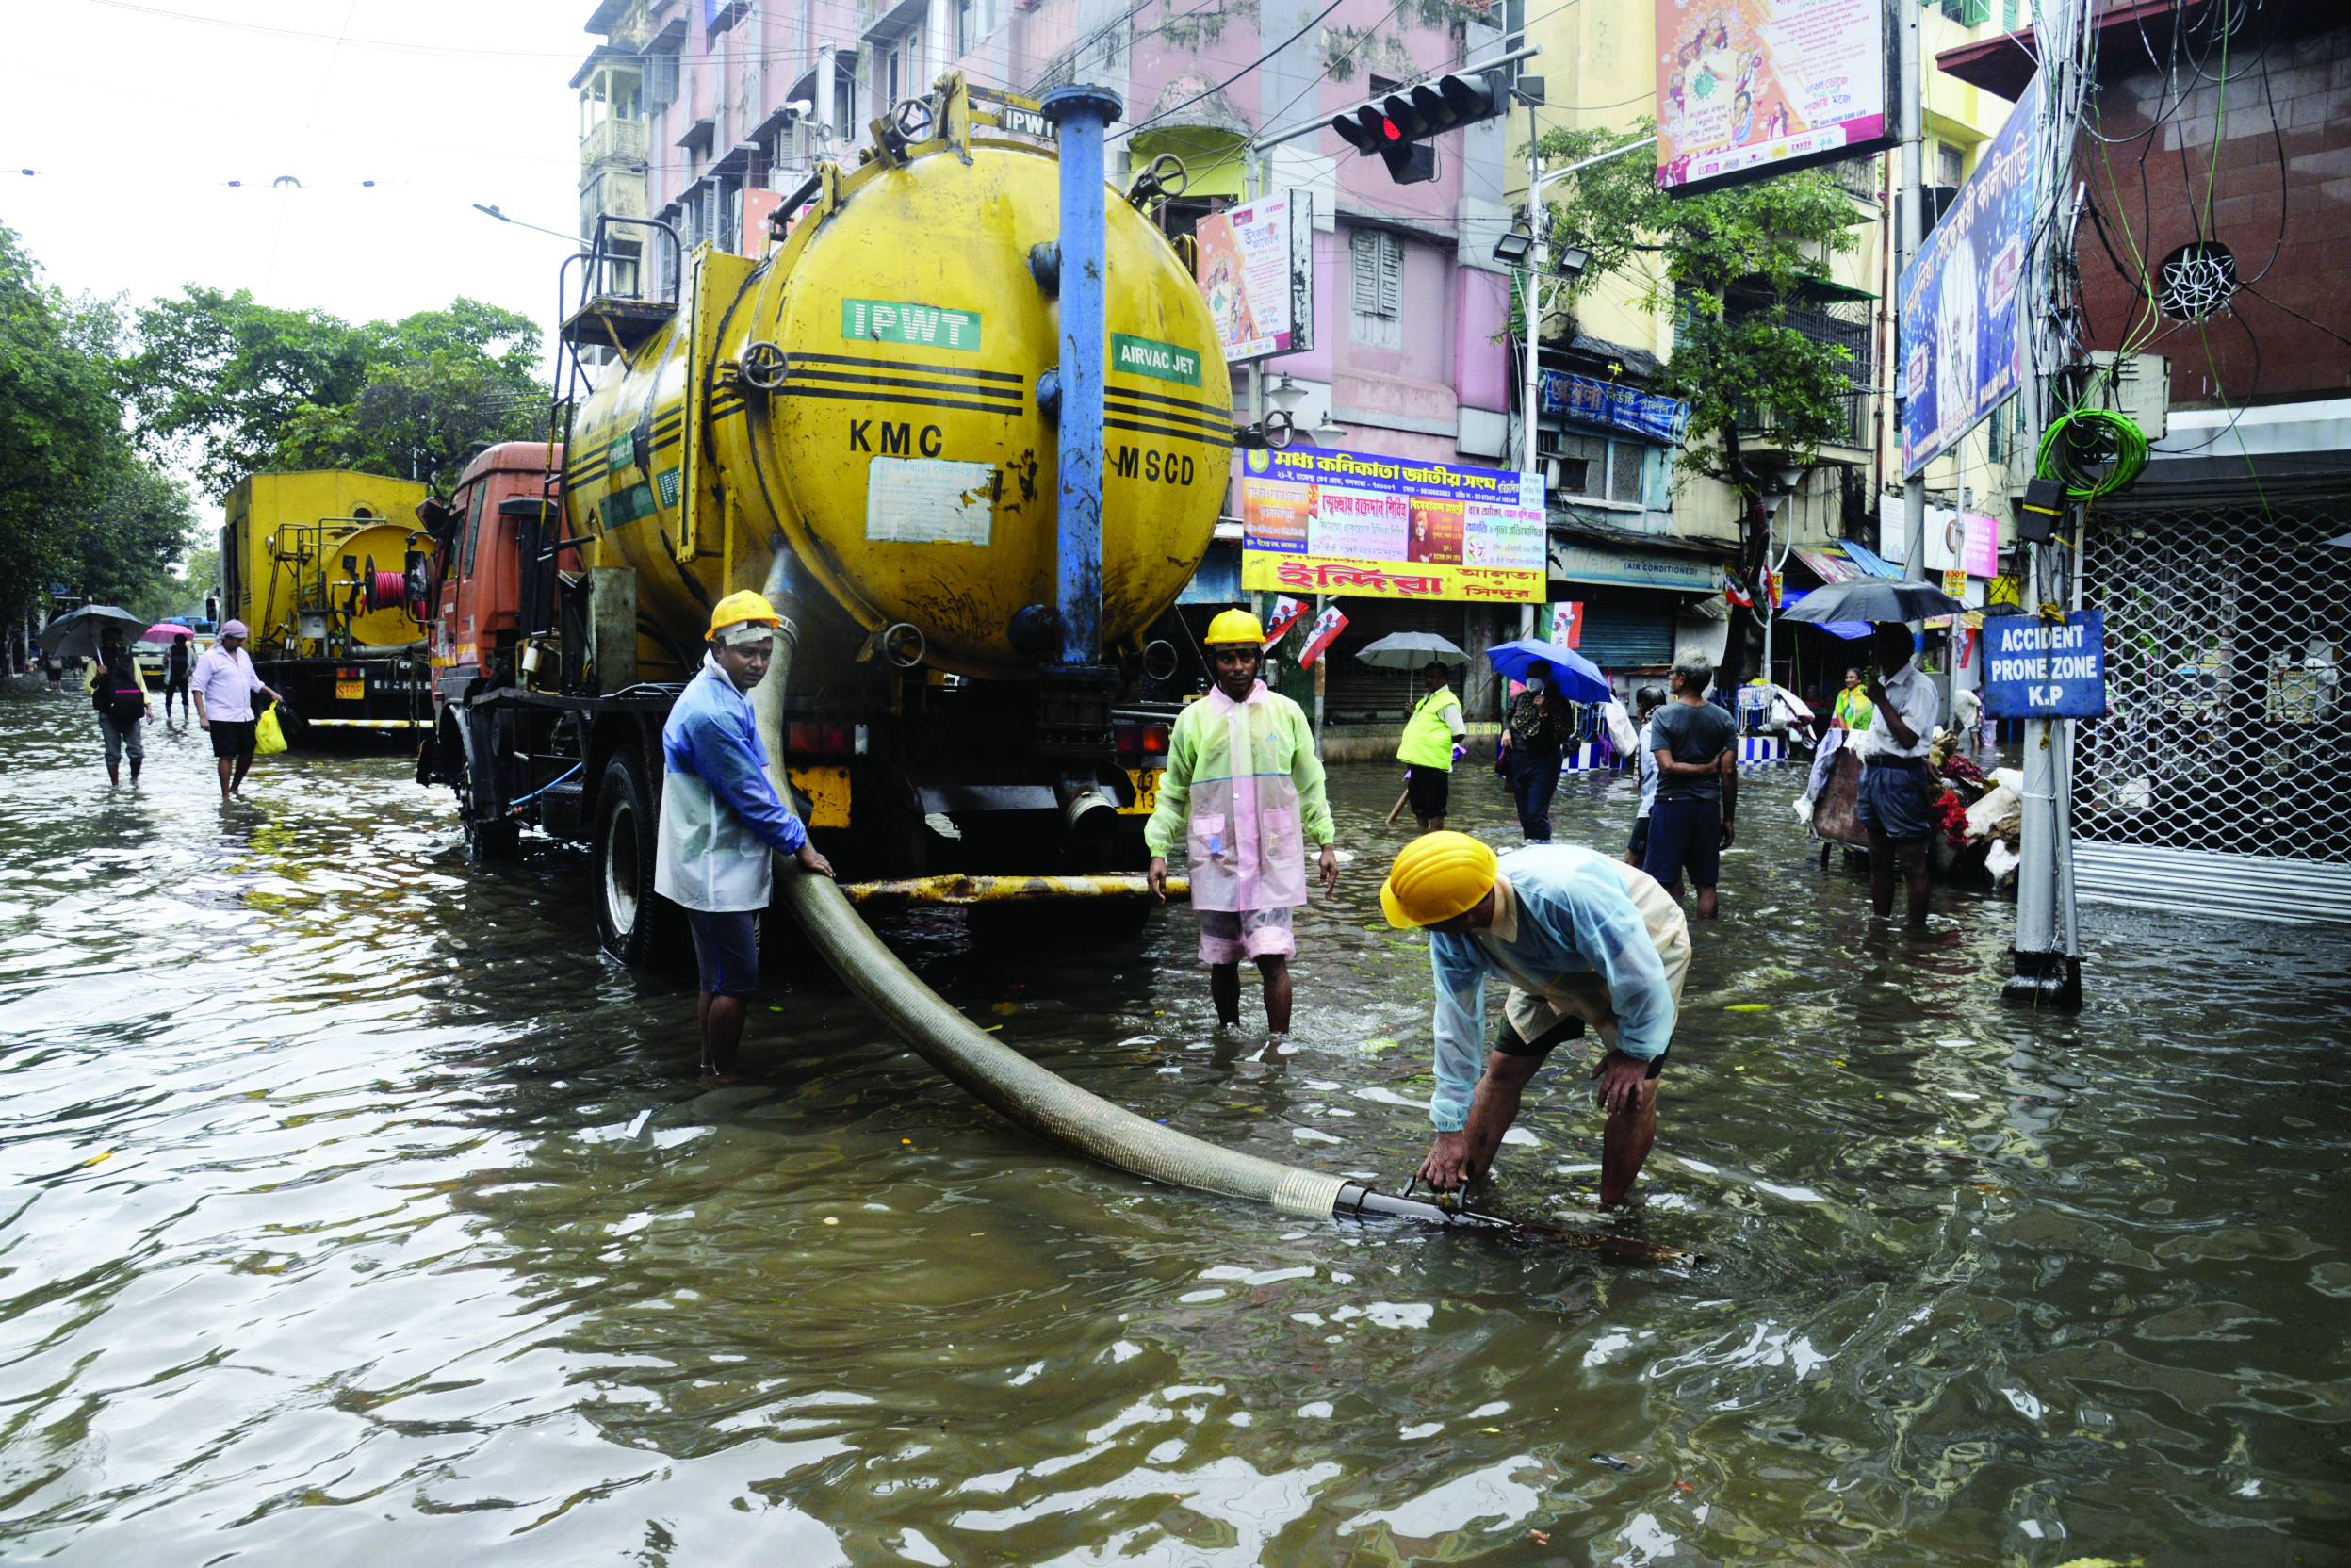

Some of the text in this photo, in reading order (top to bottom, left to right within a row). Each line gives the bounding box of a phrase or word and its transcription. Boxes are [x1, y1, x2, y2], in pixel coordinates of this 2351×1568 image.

[1830, 115, 1843, 123] DRIVE
[1844, 112, 1855, 122] SAVE
[1977, 129, 2029, 213] কালীবাড়ি
[1270, 202, 1284, 213] EXIDE
[854, 303, 969, 346] IPWT
[1121, 344, 1195, 376] AIRVAC JET
[1606, 387, 1637, 406] বিউটি
[850, 419, 943, 457] KMC
[893, 463, 930, 474] কলকাতা
[1118, 446, 1195, 487] MSCD
[1274, 450, 1314, 469] মধ্য
[1317, 452, 1400, 480] কলিকাতা
[1402, 465, 1461, 487] জাতীয়
[1462, 473, 1497, 491] সংঘ
[1297, 472, 1315, 483] রাজেন্দ্র
[1317, 474, 1327, 483] দেব
[1329, 475, 1344, 486] রোড,
[1345, 477, 1366, 488] কলকাতা
[1372, 482, 1396, 491] ৭০০০০৭
[1355, 498, 1384, 516] রক্তদান
[1385, 496, 1407, 518] শিবির
[1410, 497, 1445, 513] বিবেকানন্দ
[1468, 505, 1480, 515] বসে
[1465, 520, 1488, 535] আবৃত্তি
[1509, 523, 1543, 538] প্রতিযোগিতা
[1468, 542, 1485, 559] ২৮
[1277, 561, 1443, 596] ইন্দিরা
[1455, 566, 1539, 581] আলতা
[1624, 562, 1641, 571] (AIR
[1642, 564, 1698, 577] CONDITIONED)
[1461, 583, 1531, 600] সিন্দুর
[2001, 624, 2084, 652] ACCIDENT
[1991, 655, 2098, 682] PRONE ZONE
[337, 684, 362, 697] STOP
[2028, 685, 2064, 707] K.P
